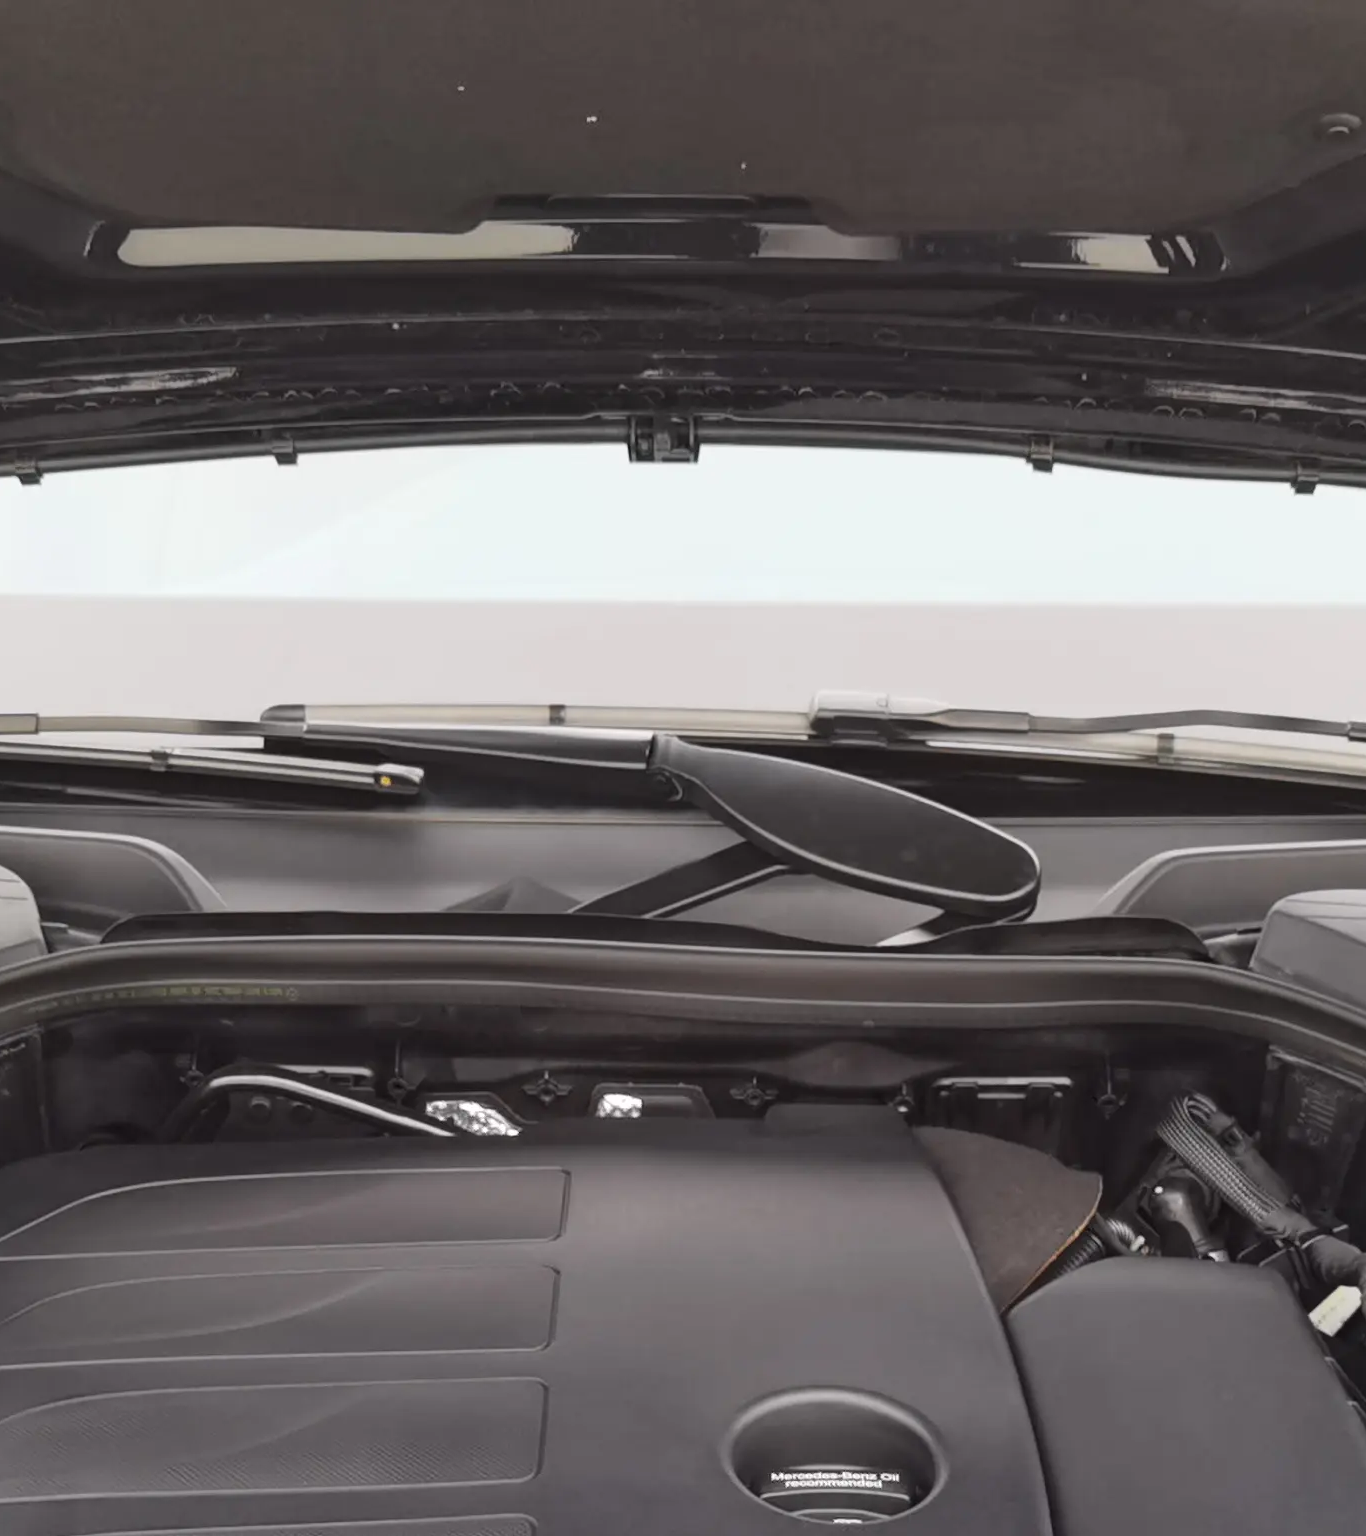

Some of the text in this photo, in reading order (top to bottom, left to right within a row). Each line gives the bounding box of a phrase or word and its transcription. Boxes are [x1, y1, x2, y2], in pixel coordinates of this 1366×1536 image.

[771, 1472, 900, 1482] Mercedes-Benz Oil
[785, 1480, 882, 1489] recommended
